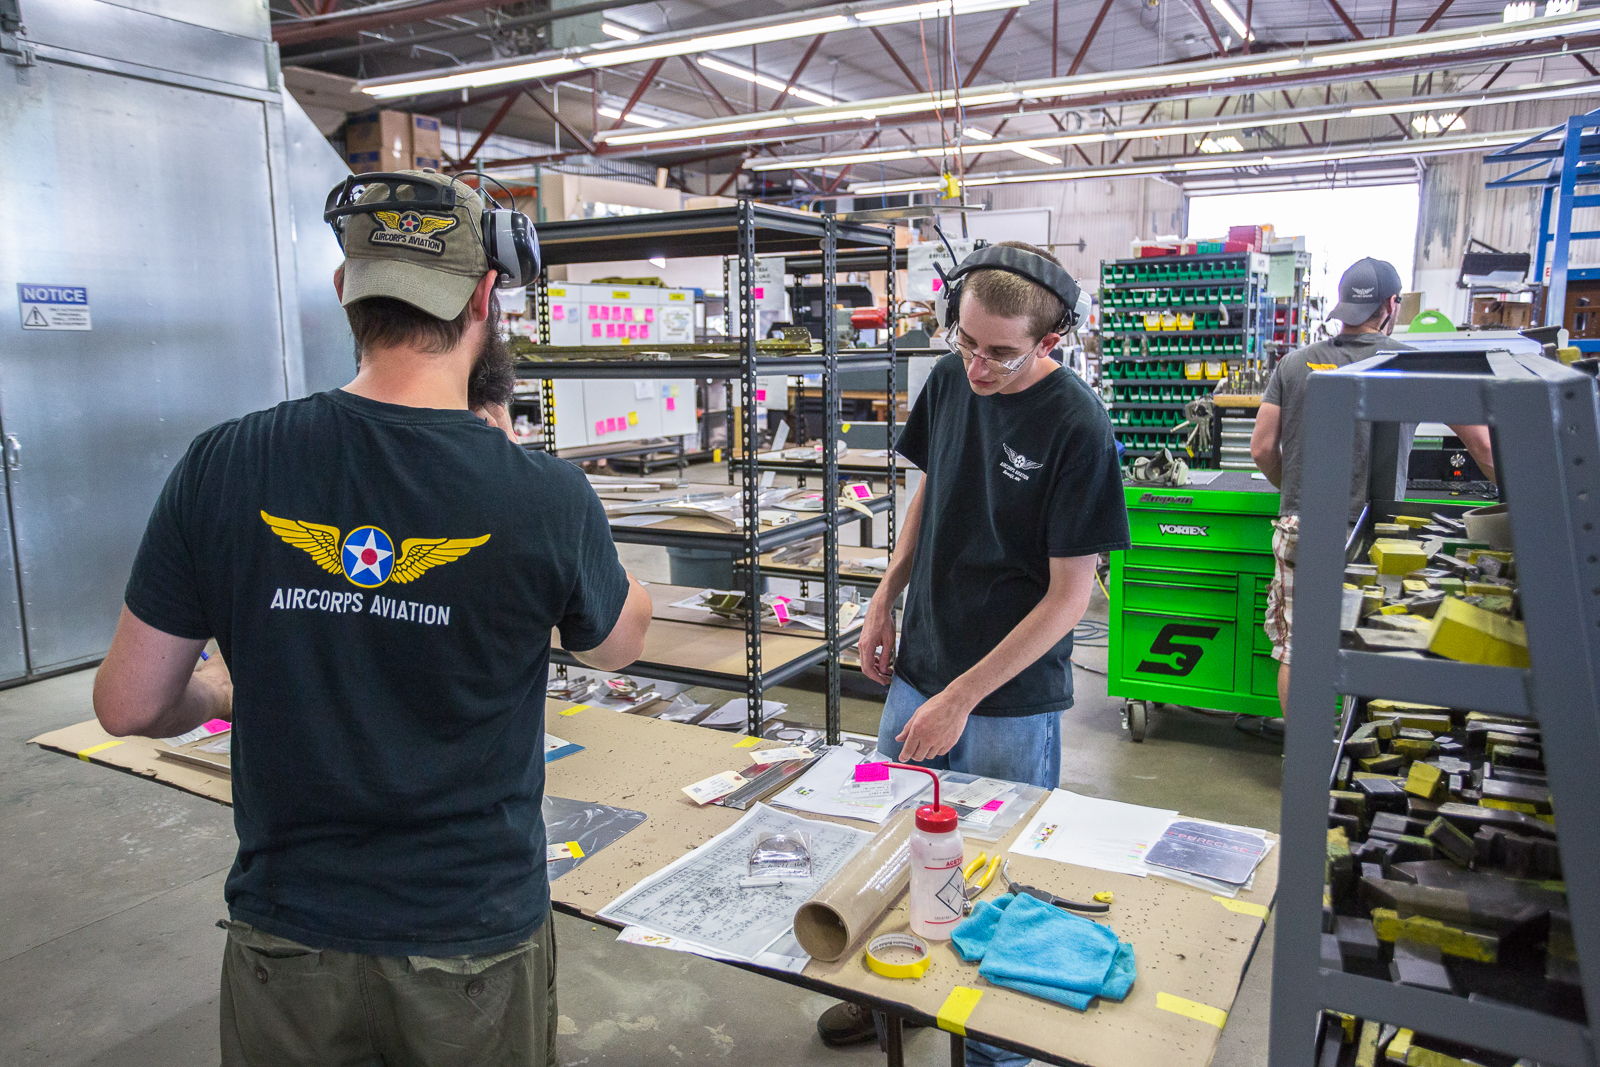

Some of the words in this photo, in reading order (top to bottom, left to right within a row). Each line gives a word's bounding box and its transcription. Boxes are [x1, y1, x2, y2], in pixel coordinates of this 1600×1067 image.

[374, 232, 407, 243] AIRCORPS
[408, 236, 441, 251] AVIATION
[23, 287, 86, 303] NOTICE
[1139, 492, 1194, 505] Snap-on
[1158, 523, 1210, 537] VORTEX
[270, 588, 364, 613] AIRCORPS
[369, 595, 451, 626] AVIATION
